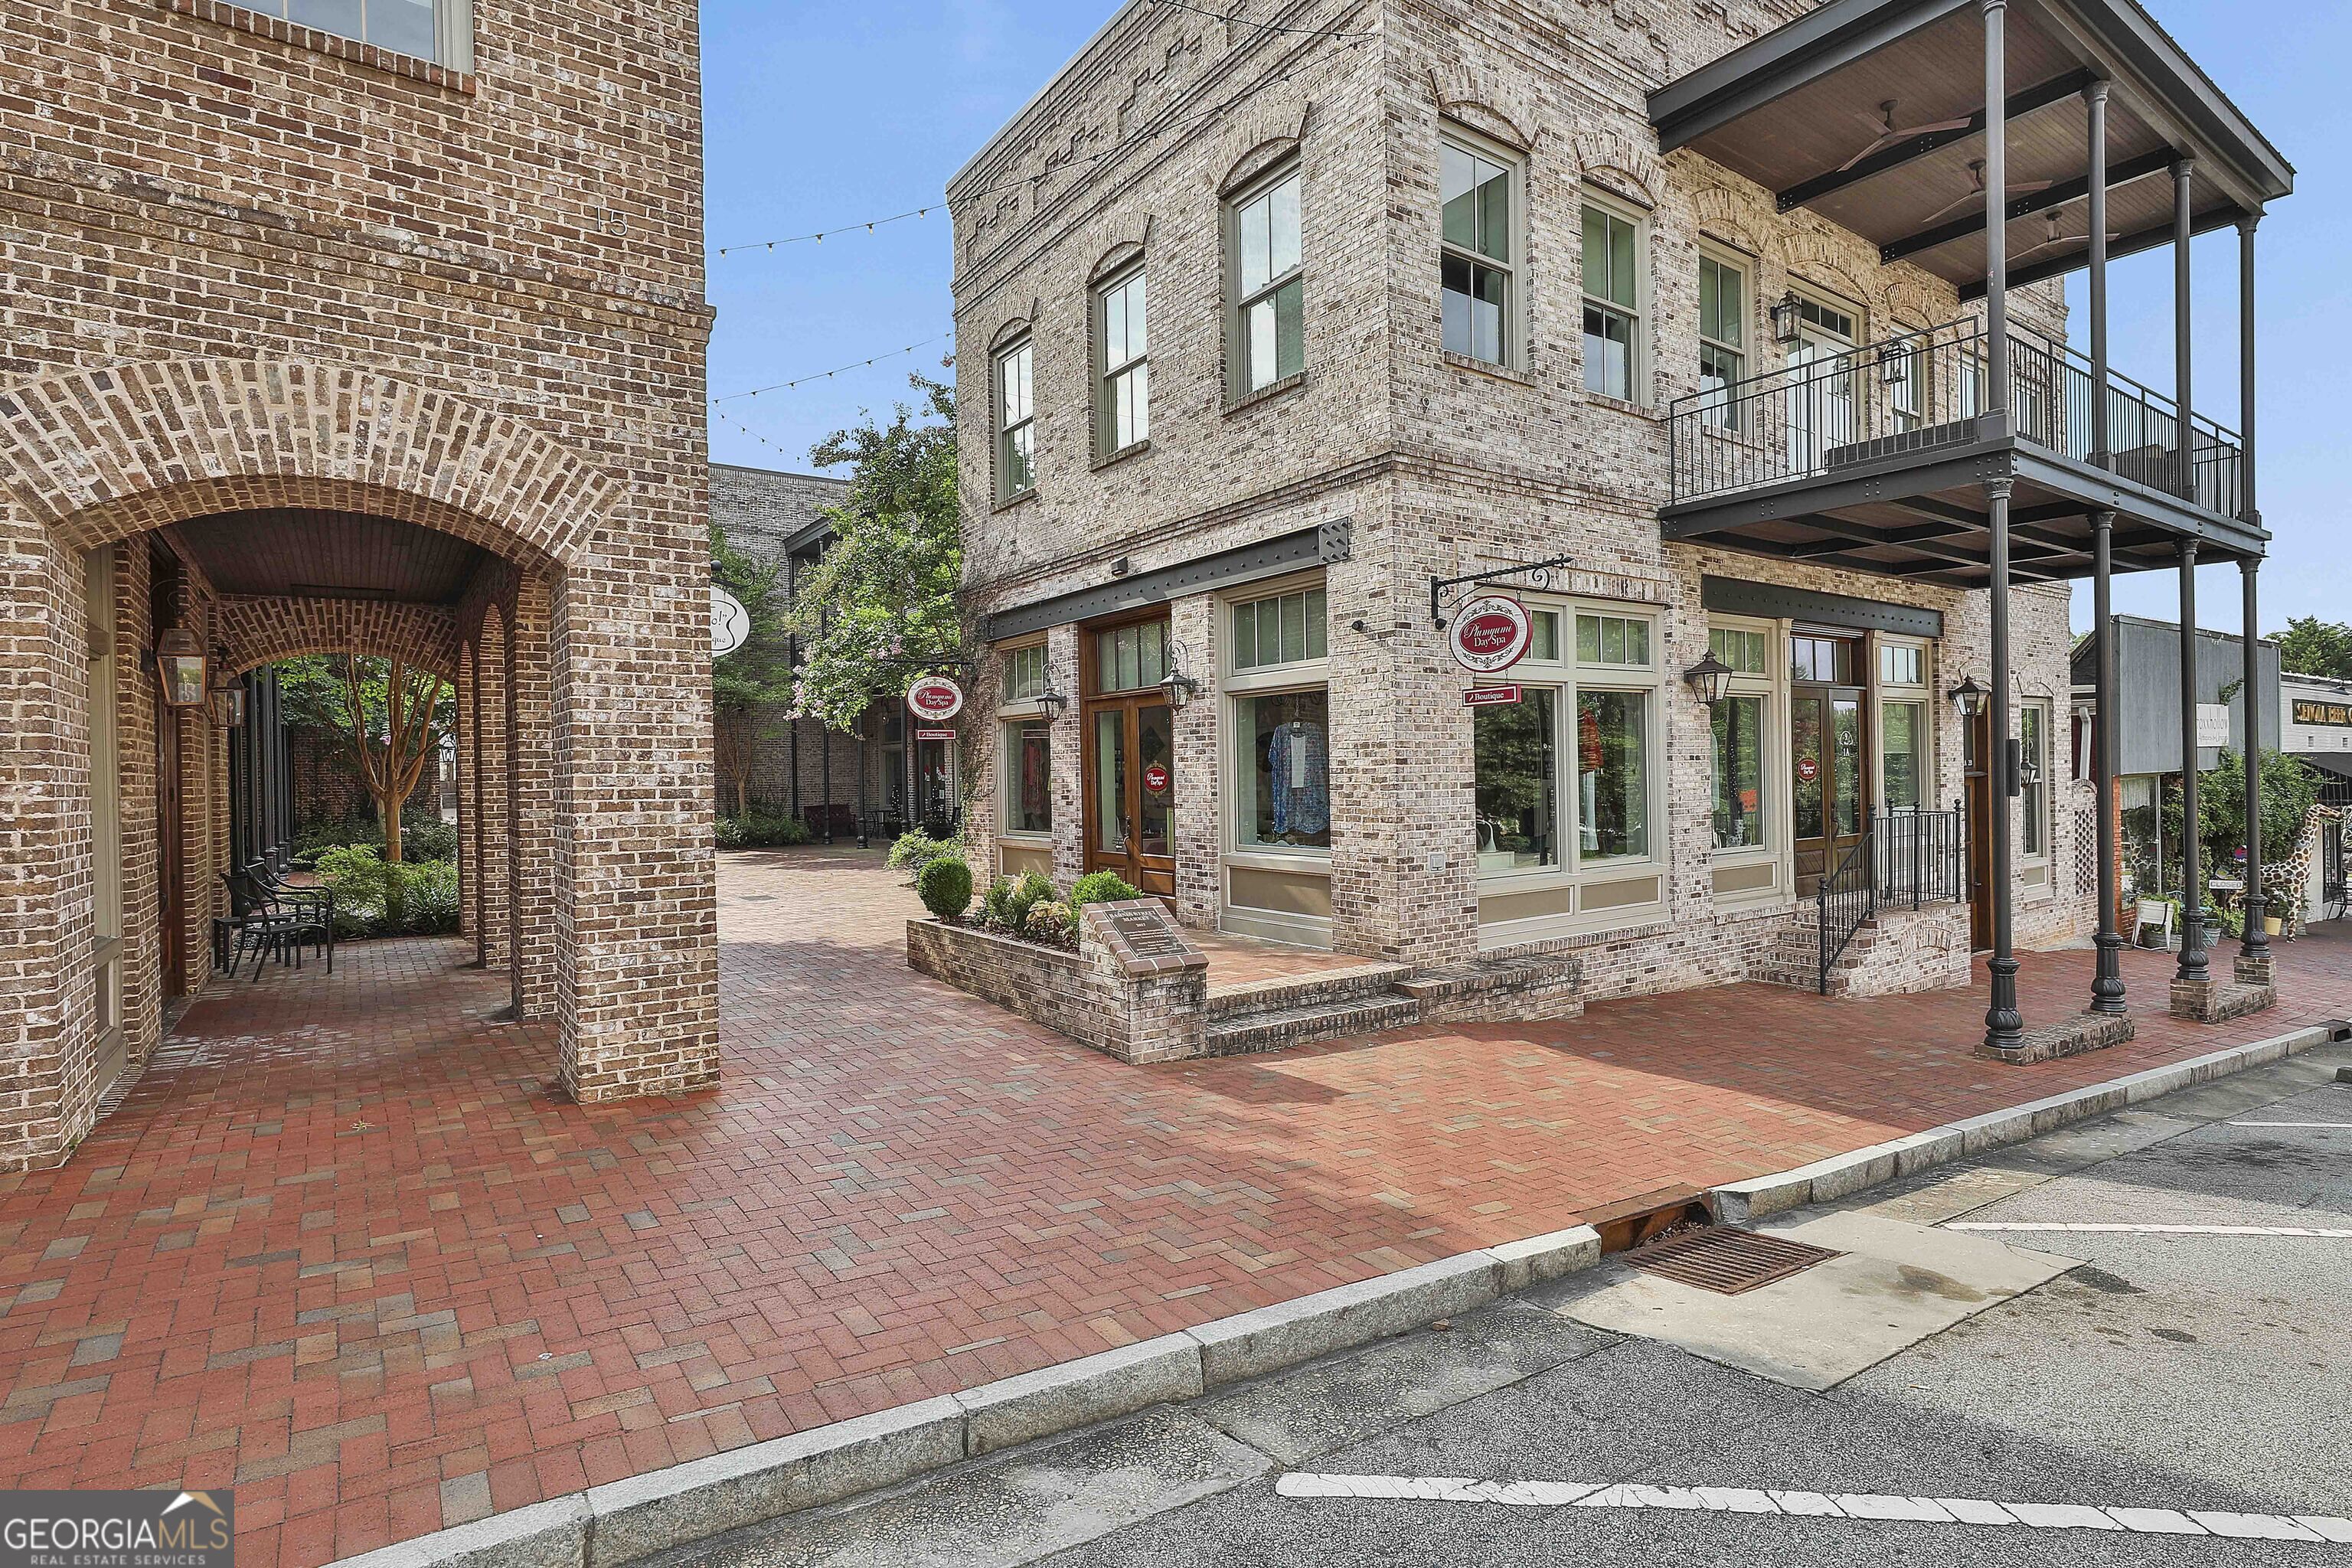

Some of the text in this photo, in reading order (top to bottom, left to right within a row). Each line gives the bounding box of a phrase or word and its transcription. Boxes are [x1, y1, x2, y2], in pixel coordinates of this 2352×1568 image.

[593, 204, 628, 236] 15
[1463, 622, 1513, 641] Plumyumi
[1474, 635, 1506, 648] Day Spa
[1475, 692, 1504, 702] Boutique
